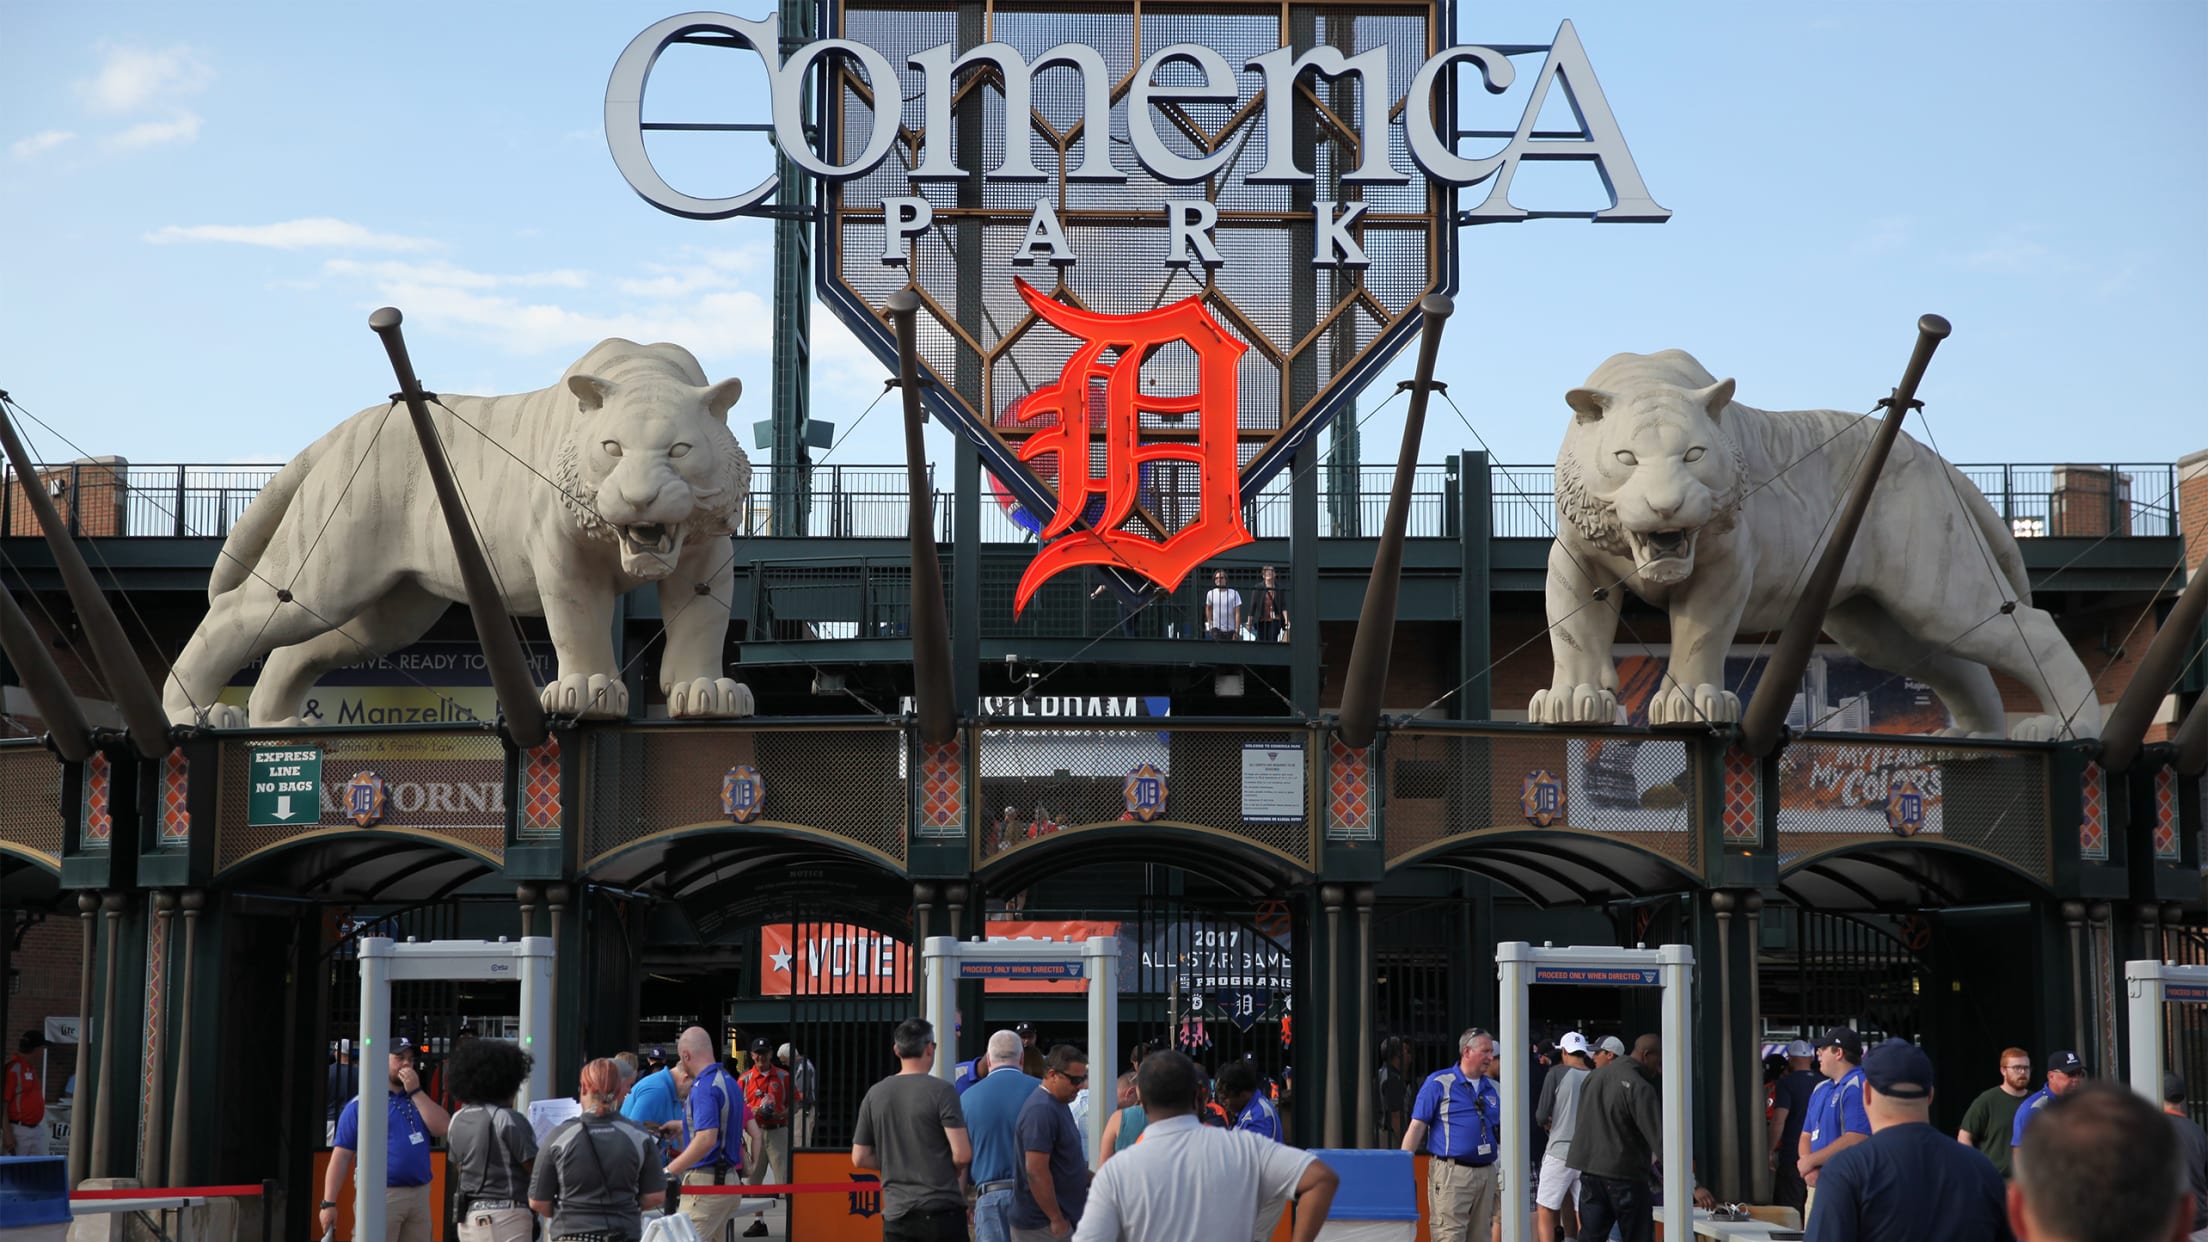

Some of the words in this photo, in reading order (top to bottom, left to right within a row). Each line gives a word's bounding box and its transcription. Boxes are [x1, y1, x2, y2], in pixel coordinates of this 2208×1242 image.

[880, 197, 1370, 269] PARK
[1013, 275, 1255, 622] D
[400, 655, 457, 669] READY
[463, 655, 486, 669] TO
[304, 699, 323, 718] &
[338, 698, 472, 723] Manzella
[256, 751, 316, 763] EXPRESS
[269, 766, 301, 777] LINE
[256, 782, 275, 793] NO
[278, 781, 313, 793] BAGS
[1195, 930, 1239, 947] 2017
[807, 937, 893, 977] VOTE
[1142, 951, 1177, 968] ALL
[1187, 951, 1234, 968] STAR
[1242, 952, 1291, 968] GAME
[962, 966, 992, 974] PROCEED
[994, 966, 1010, 974] ONLY
[1012, 966, 1031, 974] WHEN
[1032, 966, 1065, 974] DIRECTED
[1538, 971, 1568, 979] PROCEED
[1569, 971, 1586, 979] ONLY
[1587, 972, 1607, 980] WHEN
[1608, 973, 1641, 981] DIRECTED
[1196, 976, 1292, 987] PROGRAMS
[52, 1123, 71, 1140] Lit
